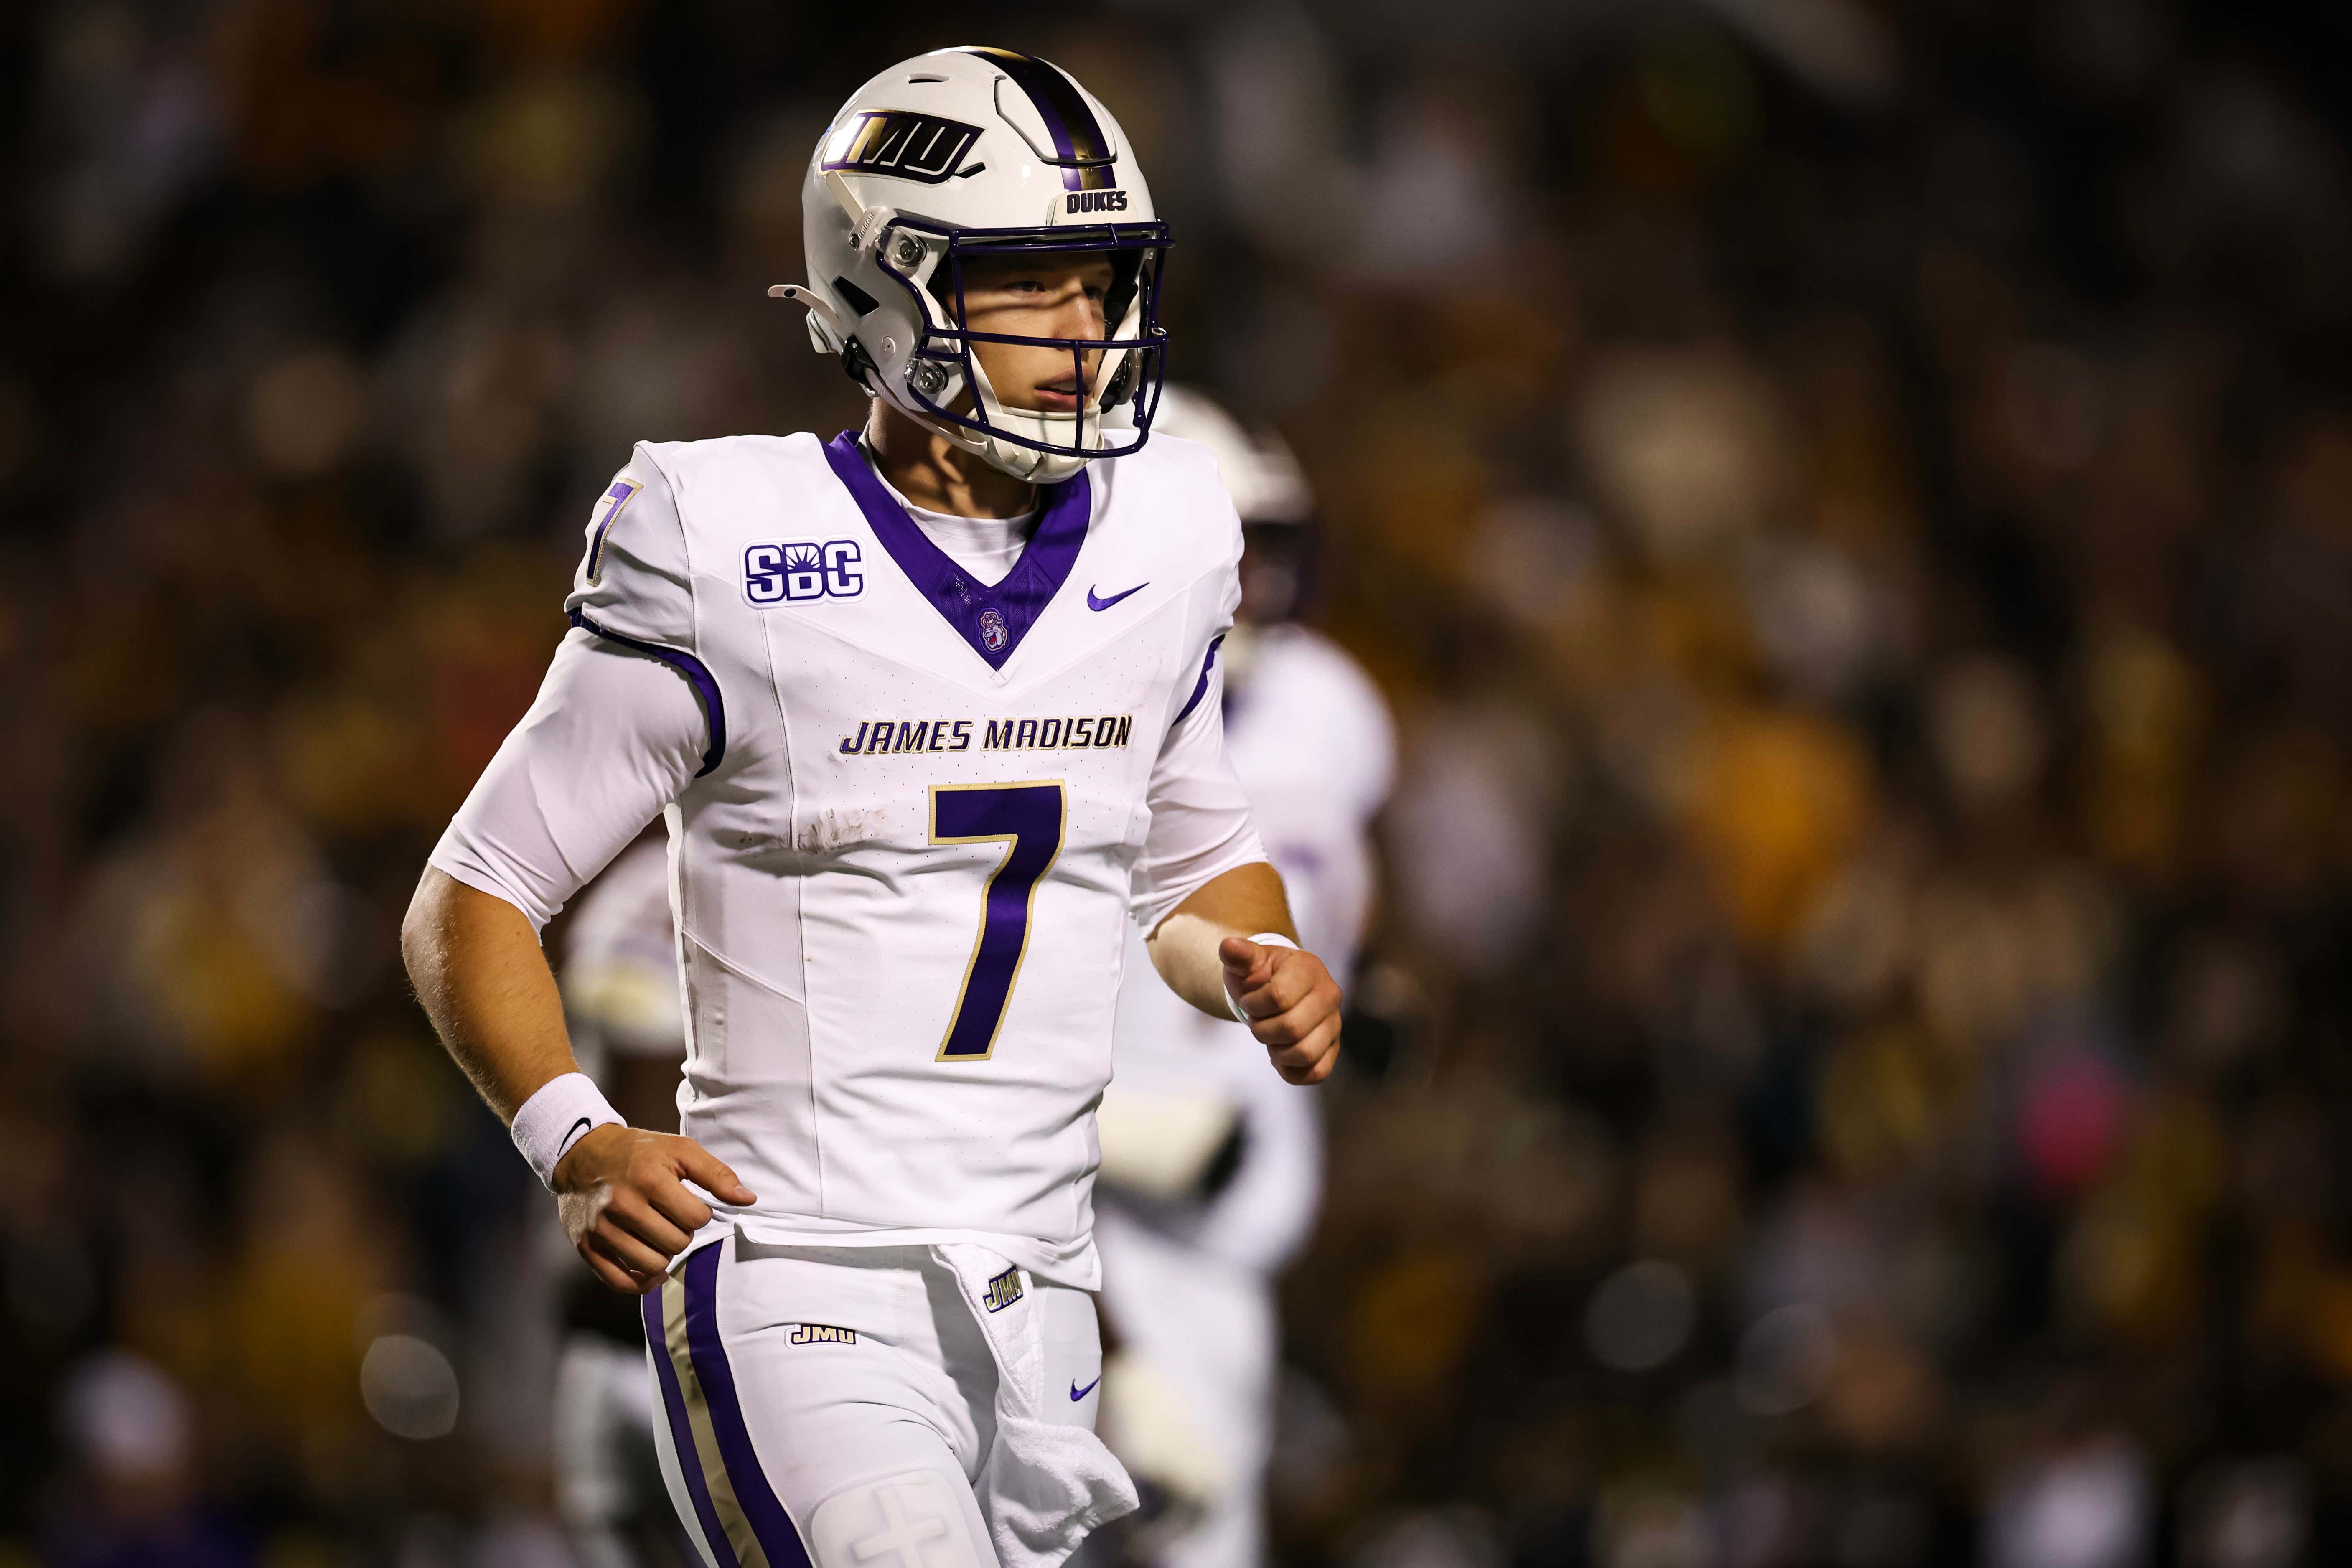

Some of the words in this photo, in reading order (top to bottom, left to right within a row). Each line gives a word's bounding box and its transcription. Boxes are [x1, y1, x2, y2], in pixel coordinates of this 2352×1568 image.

[1067, 191, 1128, 214] DUKES
[586, 477, 644, 587] 7
[745, 540, 863, 603] SBC
[840, 719, 974, 754] JAMES
[981, 714, 1132, 751] MADISON
[928, 779, 1067, 1062] 7
[983, 1266, 1023, 1313] JMU
[791, 1325, 856, 1344] JMU
